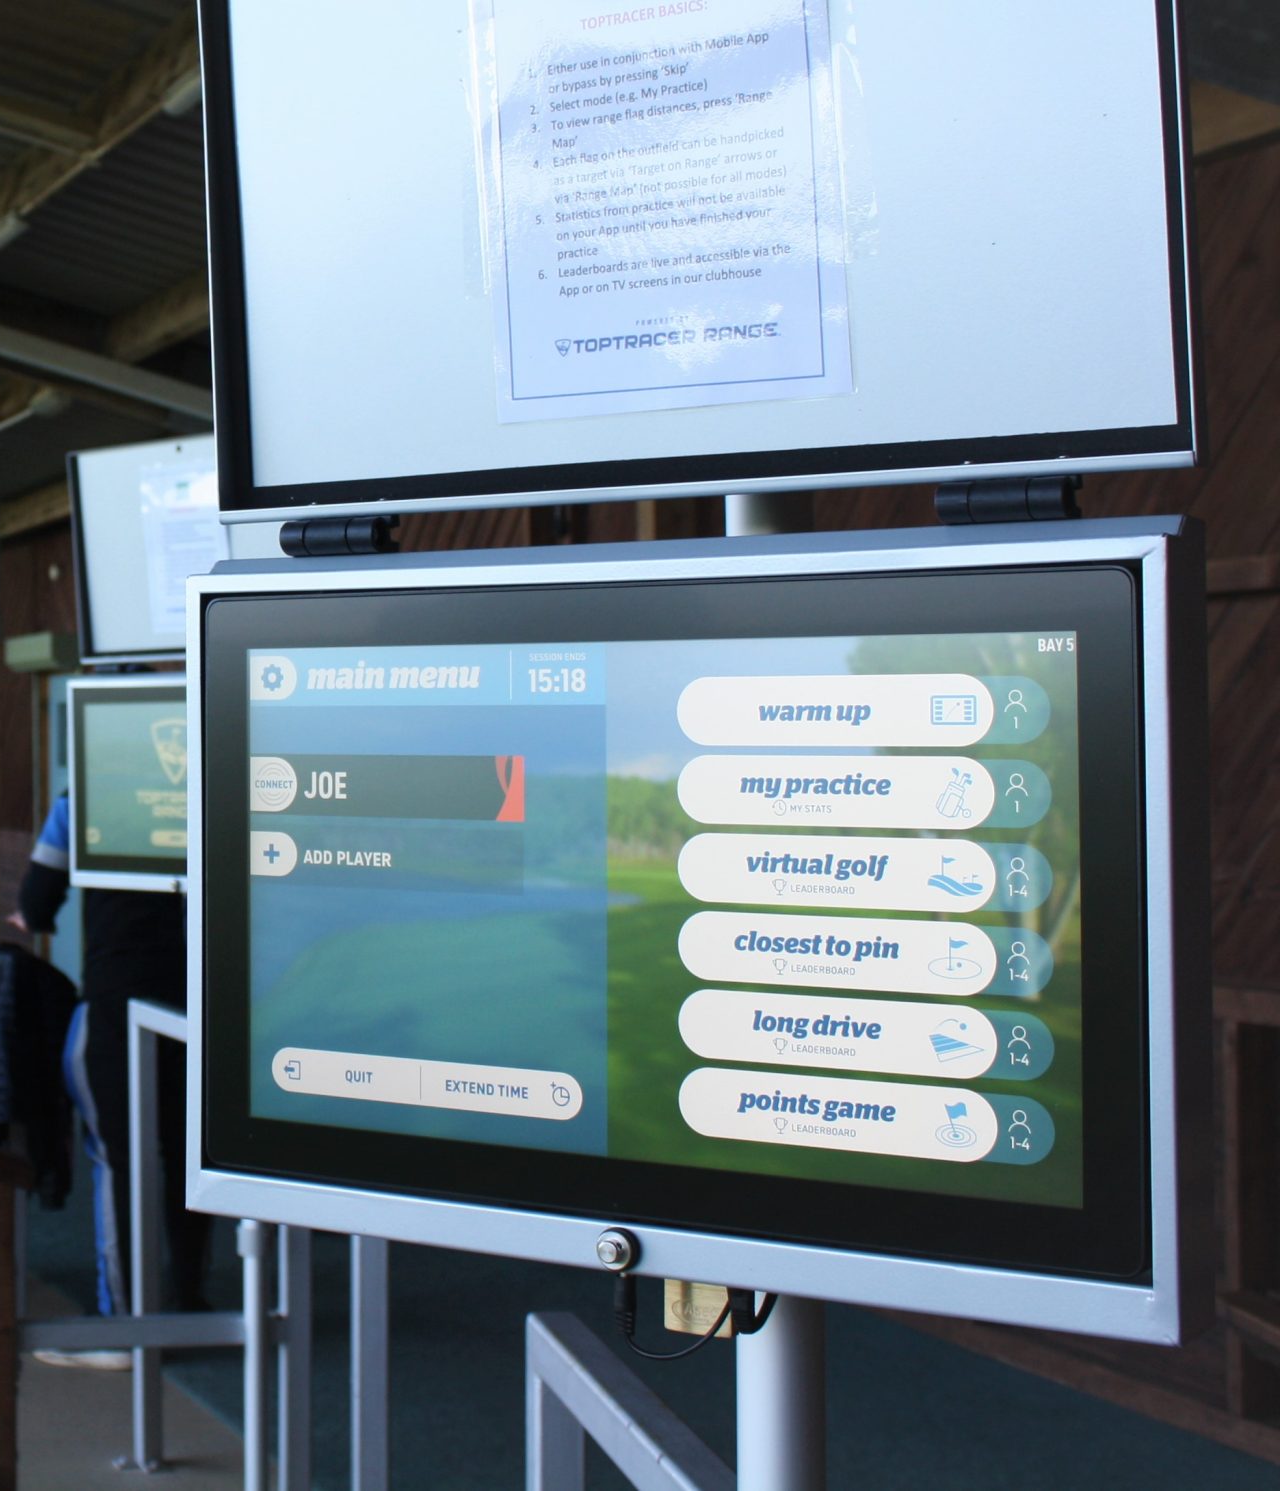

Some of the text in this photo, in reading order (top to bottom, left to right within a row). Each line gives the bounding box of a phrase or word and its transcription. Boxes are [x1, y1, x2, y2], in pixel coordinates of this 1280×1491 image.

[580, 0, 708, 30] TOPTRACER BASICS:
[547, 61, 577, 75] Either
[580, 59, 598, 71] use
[600, 56, 610, 67] in
[613, 48, 675, 64] conjunction
[678, 41, 702, 55] with
[705, 35, 744, 50] Mobile
[746, 32, 769, 45] App
[548, 84, 560, 94] or
[562, 78, 597, 93] bypass
[600, 75, 612, 87] by
[614, 69, 659, 86] pressing
[530, 79, 708, 115] 2. Select mode (e.g. My Practice)
[531, 123, 540, 133] 3.
[551, 119, 564, 131] To
[566, 117, 589, 129] view
[593, 112, 623, 125] range
[625, 108, 644, 120] flag
[647, 102, 700, 117] distances,
[703, 97, 732, 111] press
[553, 154, 577, 168] Each
[580, 151, 599, 164] flag
[601, 151, 614, 161] on
[617, 147, 634, 159] the
[637, 140, 679, 156] outfield
[681, 140, 701, 150] can
[704, 136, 717, 147] be
[720, 126, 784, 145] handpicked
[554, 176, 564, 186] as
[568, 176, 573, 184] a
[577, 170, 607, 183] target
[609, 168, 624, 178] via
[668, 160, 681, 171] on
[724, 151, 762, 164] arrows
[765, 149, 778, 158] or
[554, 193, 569, 204] via
[640, 182, 661, 196] (not
[664, 175, 708, 192] possible
[711, 174, 727, 185] for
[730, 170, 742, 182] all
[746, 165, 787, 181] modes)
[535, 185, 786, 225] 5. Statistics from practice will not be available
[556, 207, 772, 241] on your App until you have finished your
[538, 243, 792, 280] 6. Leaderboards are live and accessible via the
[557, 246, 598, 261] practice
[559, 267, 762, 298] App or on TV screens in our clubhouse
[573, 322, 778, 354] TOPTRACER RANGE
[528, 651, 586, 661] SESSION ENDS
[1037, 637, 1075, 653] BAY 5
[306, 660, 480, 690] main menu
[528, 668, 586, 693] 15:18
[758, 704, 871, 726] warm up
[1013, 716, 1019, 730] 1
[254, 779, 293, 790] CONNECT
[303, 771, 348, 800] JOE
[739, 773, 892, 800] my practice
[789, 804, 832, 814] MY STATS
[1014, 800, 1020, 814] 1
[303, 849, 392, 868] ADD PLAYER
[746, 850, 889, 882] virtual golf
[790, 882, 856, 896] LEADERBOARD
[1008, 884, 1028, 898] 1-4
[734, 931, 900, 963] closest to pin
[790, 964, 856, 977] LEADERBOARD
[1008, 968, 1029, 982] 1-4
[752, 1010, 882, 1040] long drive
[791, 1043, 857, 1057] LEADERBOARD
[1009, 1052, 1030, 1067] 1-4
[345, 1069, 373, 1084] QUIT
[445, 1079, 529, 1100] EXTEND TIME
[737, 1090, 897, 1122] points game
[791, 1123, 857, 1138] LEADERBOARD
[1009, 1136, 1030, 1151] 1-4
